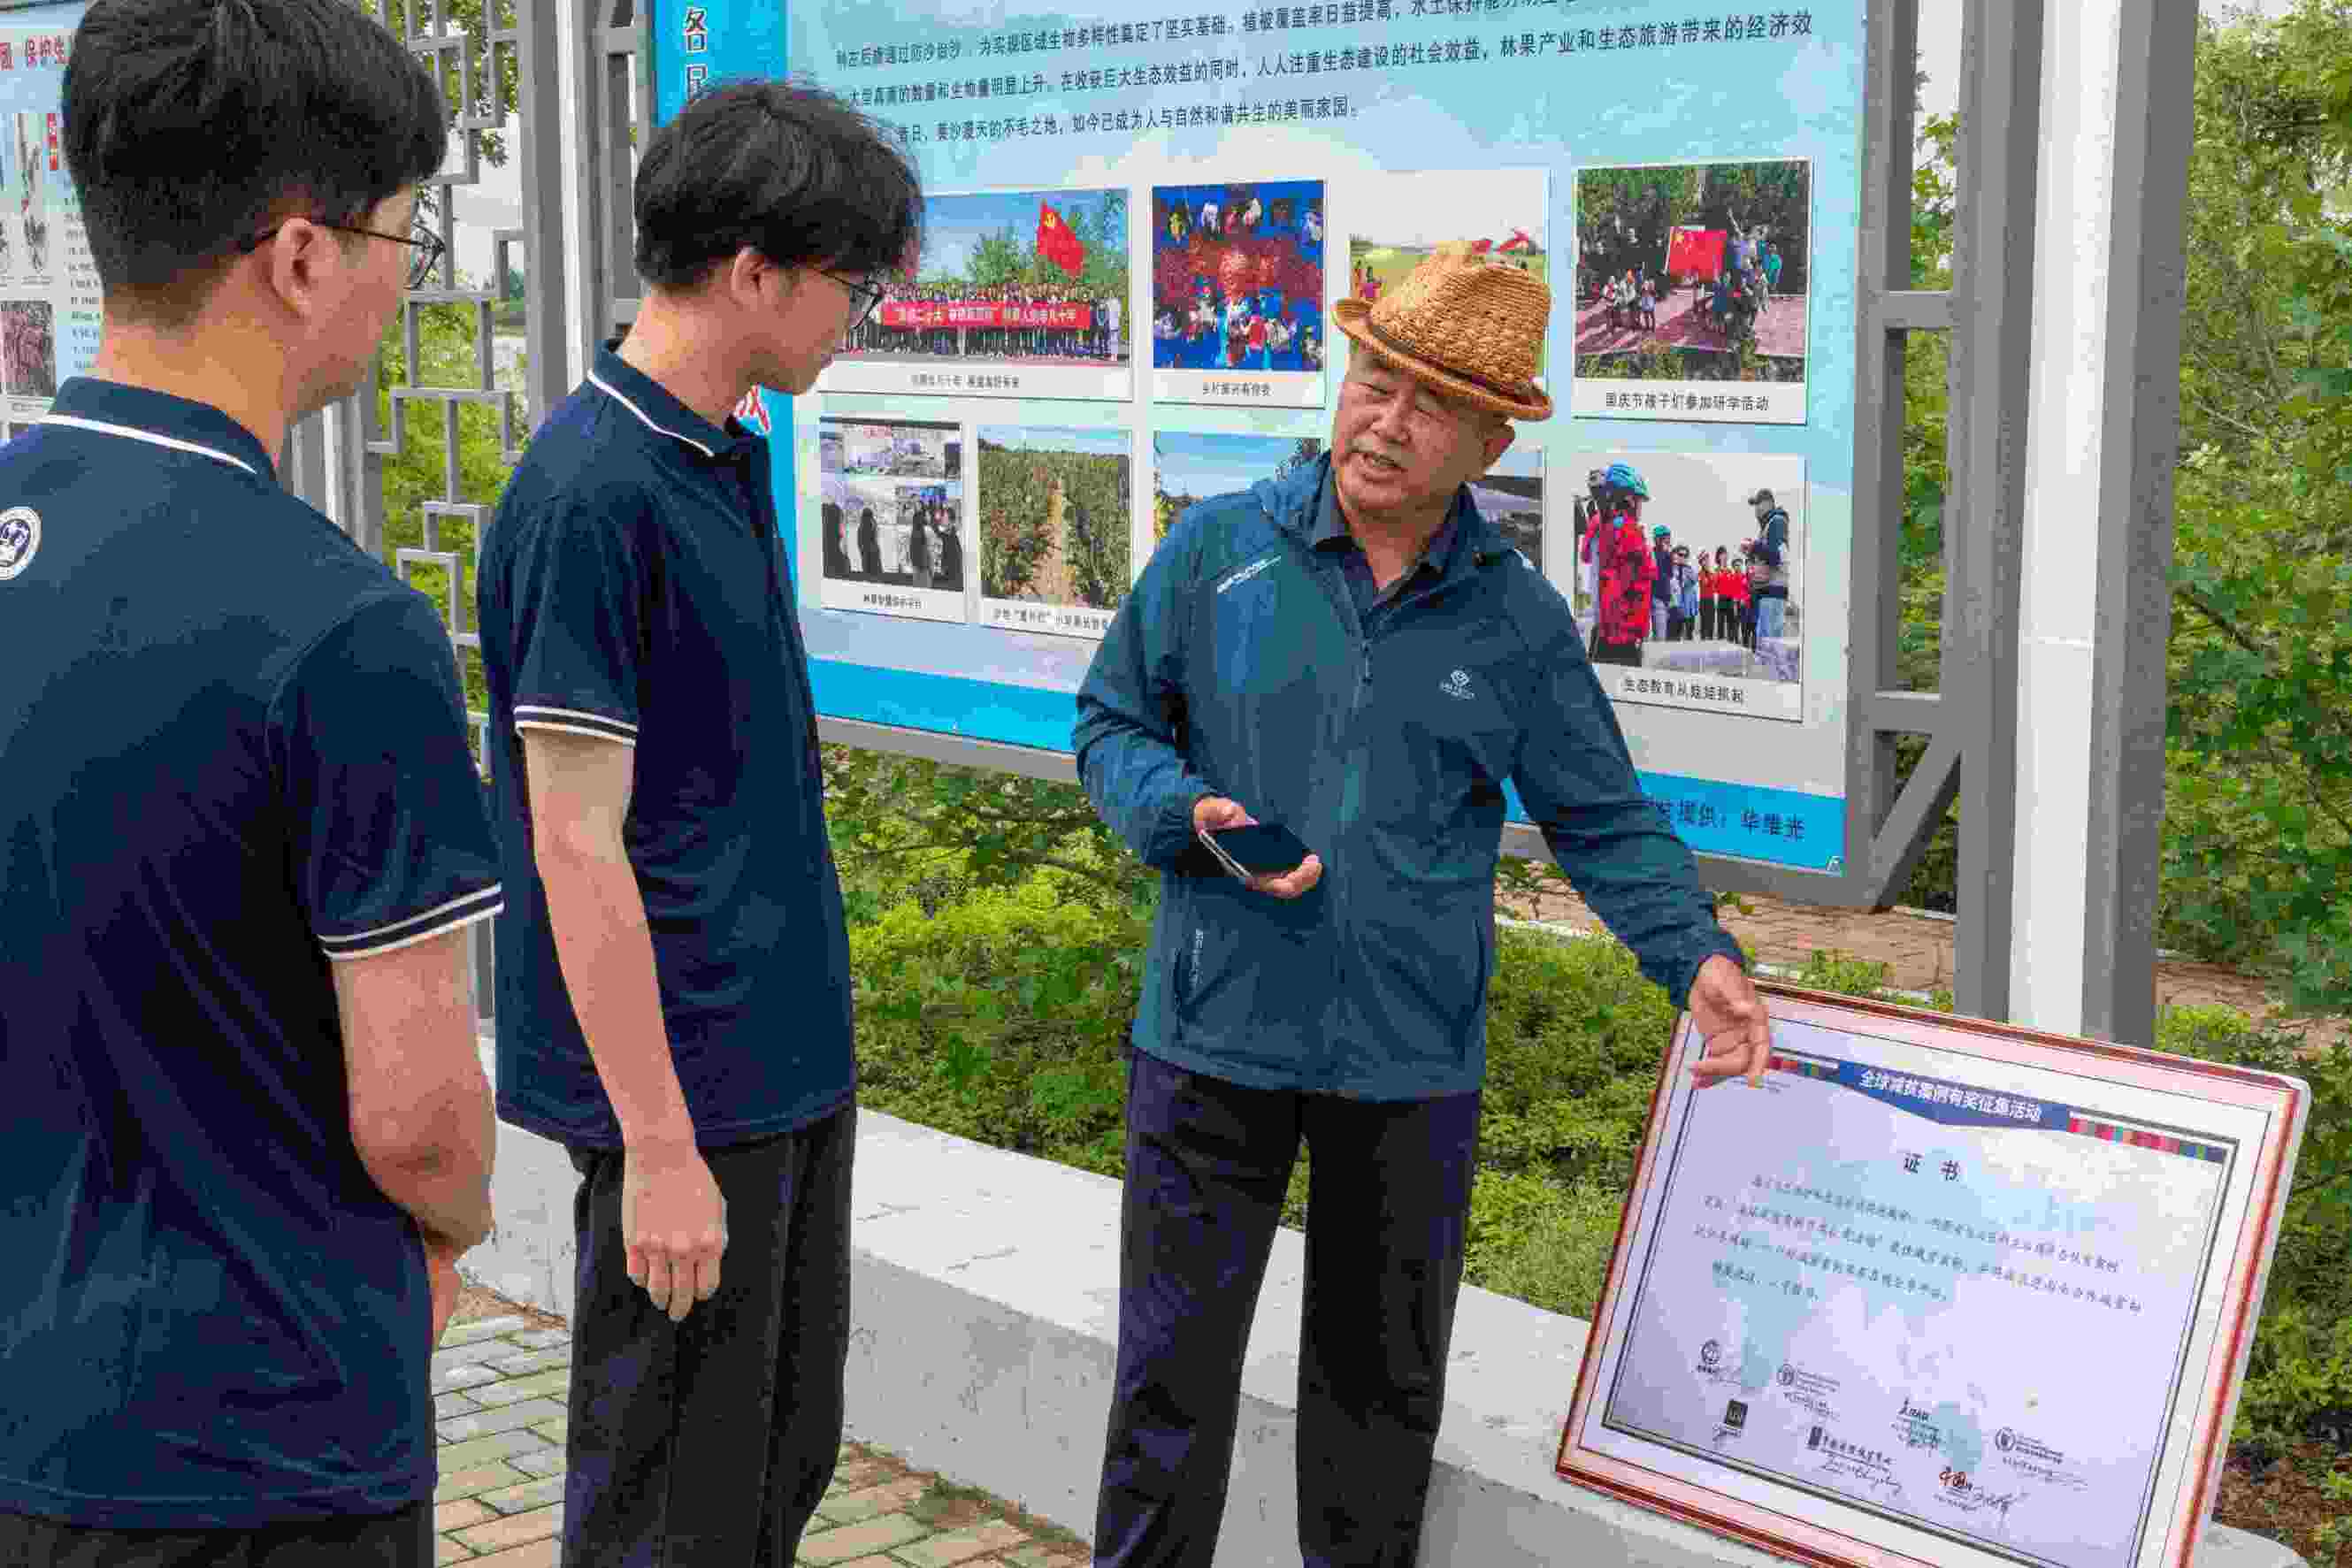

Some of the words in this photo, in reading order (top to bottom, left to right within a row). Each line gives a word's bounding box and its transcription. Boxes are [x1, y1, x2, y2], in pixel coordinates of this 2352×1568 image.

[1605, 391, 1770, 411] 国庆节孩子们参加研学活动
[1624, 678, 1743, 702] 生态教育从娃娃抓起
